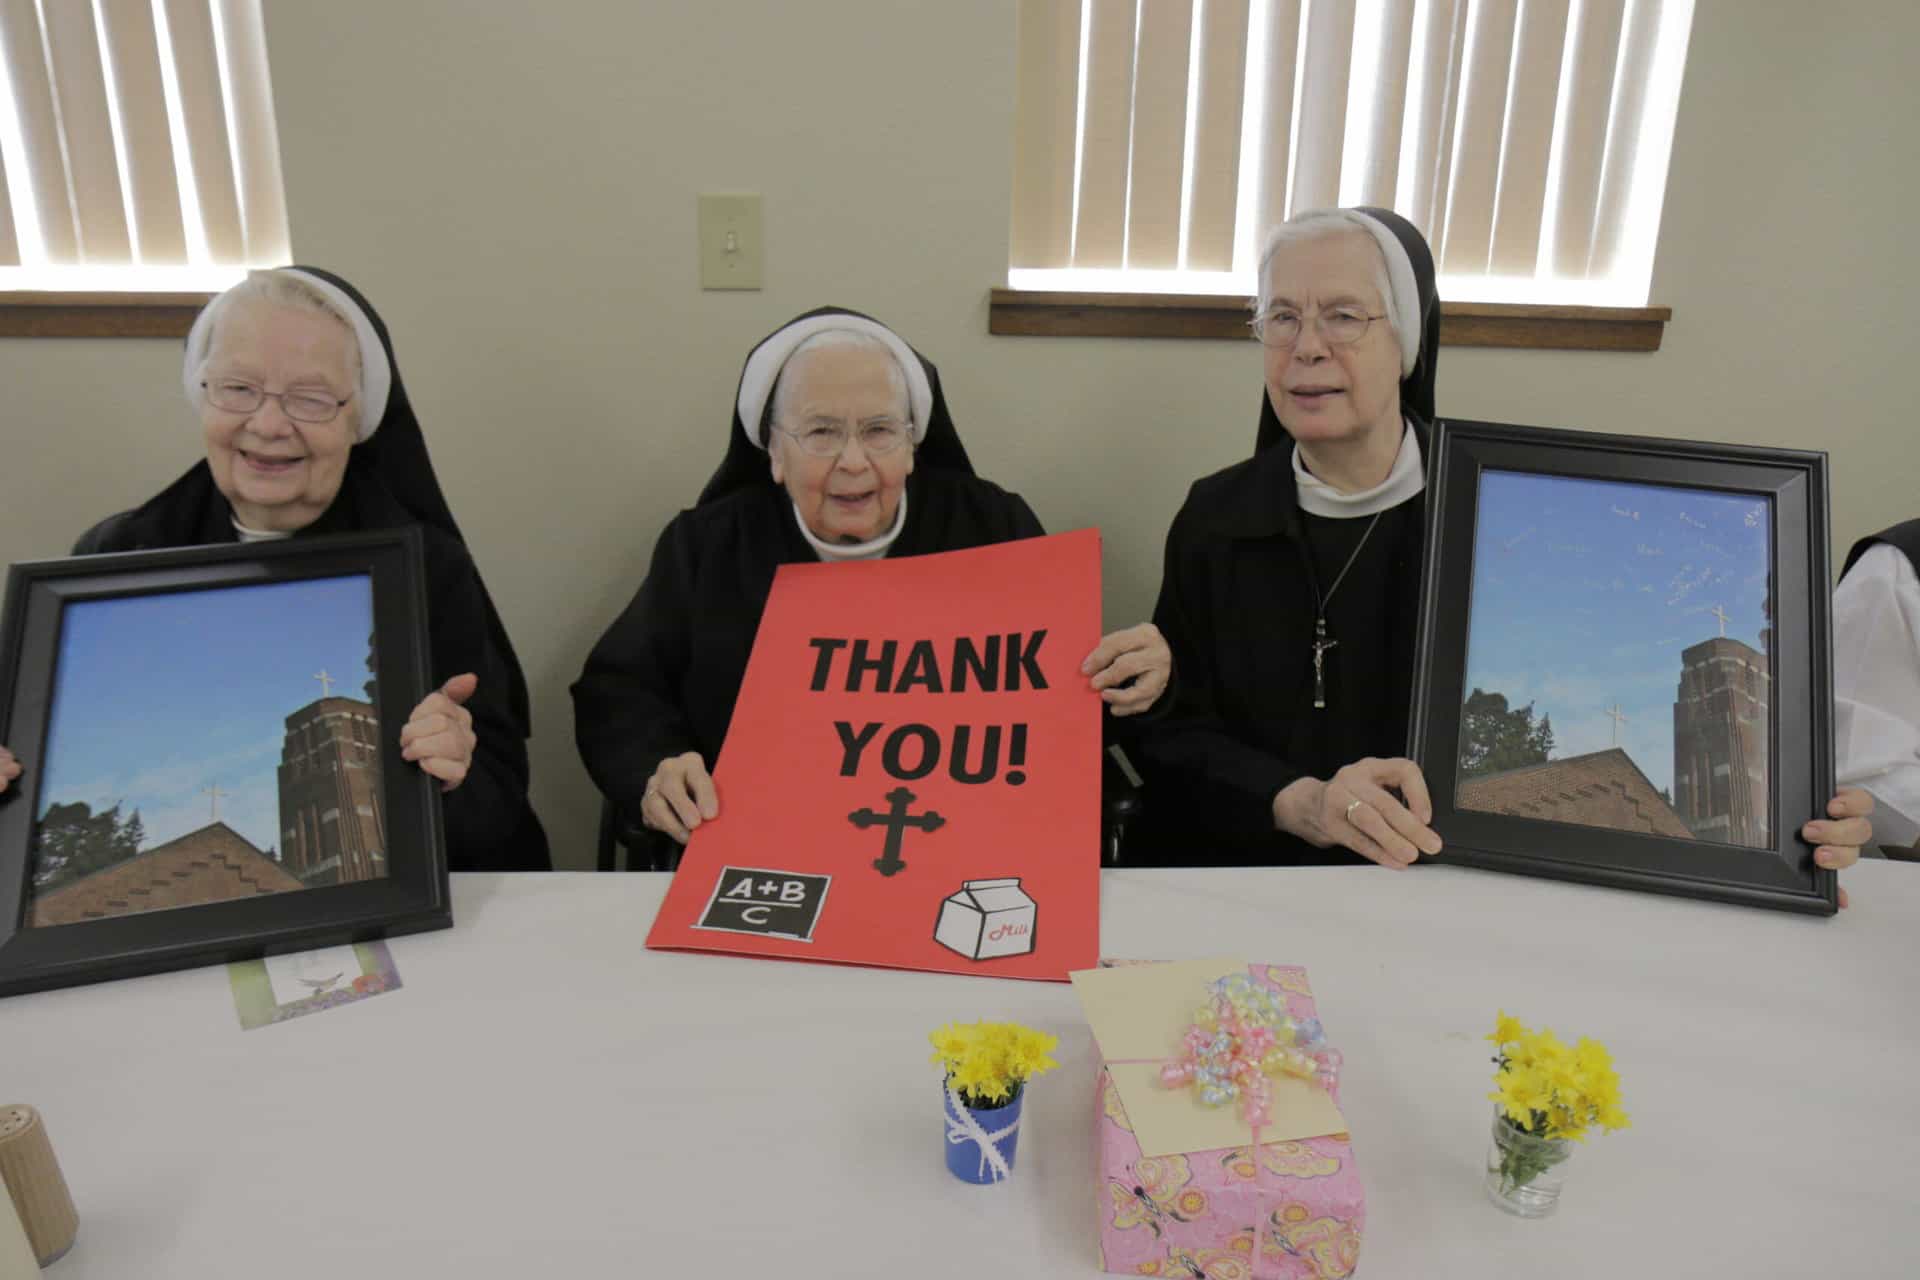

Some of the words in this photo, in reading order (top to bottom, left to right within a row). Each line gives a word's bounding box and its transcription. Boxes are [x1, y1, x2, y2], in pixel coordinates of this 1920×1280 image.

[809, 629, 1049, 694] THANK
[833, 720, 1029, 786] YOU!
[725, 876, 806, 903] A+B
[740, 906, 772, 925] C
[988, 923, 1029, 942] Milk
